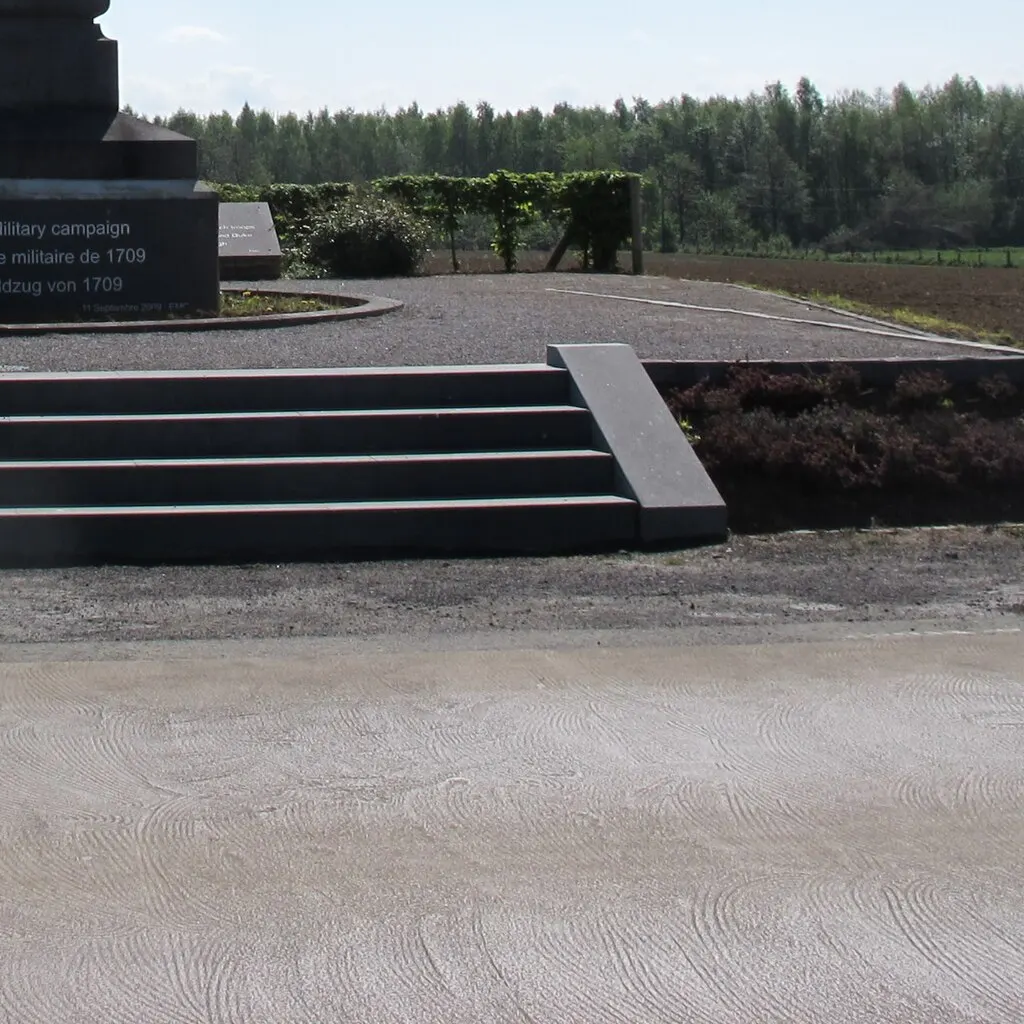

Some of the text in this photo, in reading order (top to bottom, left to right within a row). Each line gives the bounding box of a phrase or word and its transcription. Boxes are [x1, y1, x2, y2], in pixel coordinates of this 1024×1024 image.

[51, 220, 131, 239] campaign
[11, 249, 75, 265] militaire
[79, 248, 101, 264] de
[106, 247, 146, 263] 1709
[47, 280, 77, 294] von
[83, 276, 123, 292] 1709
